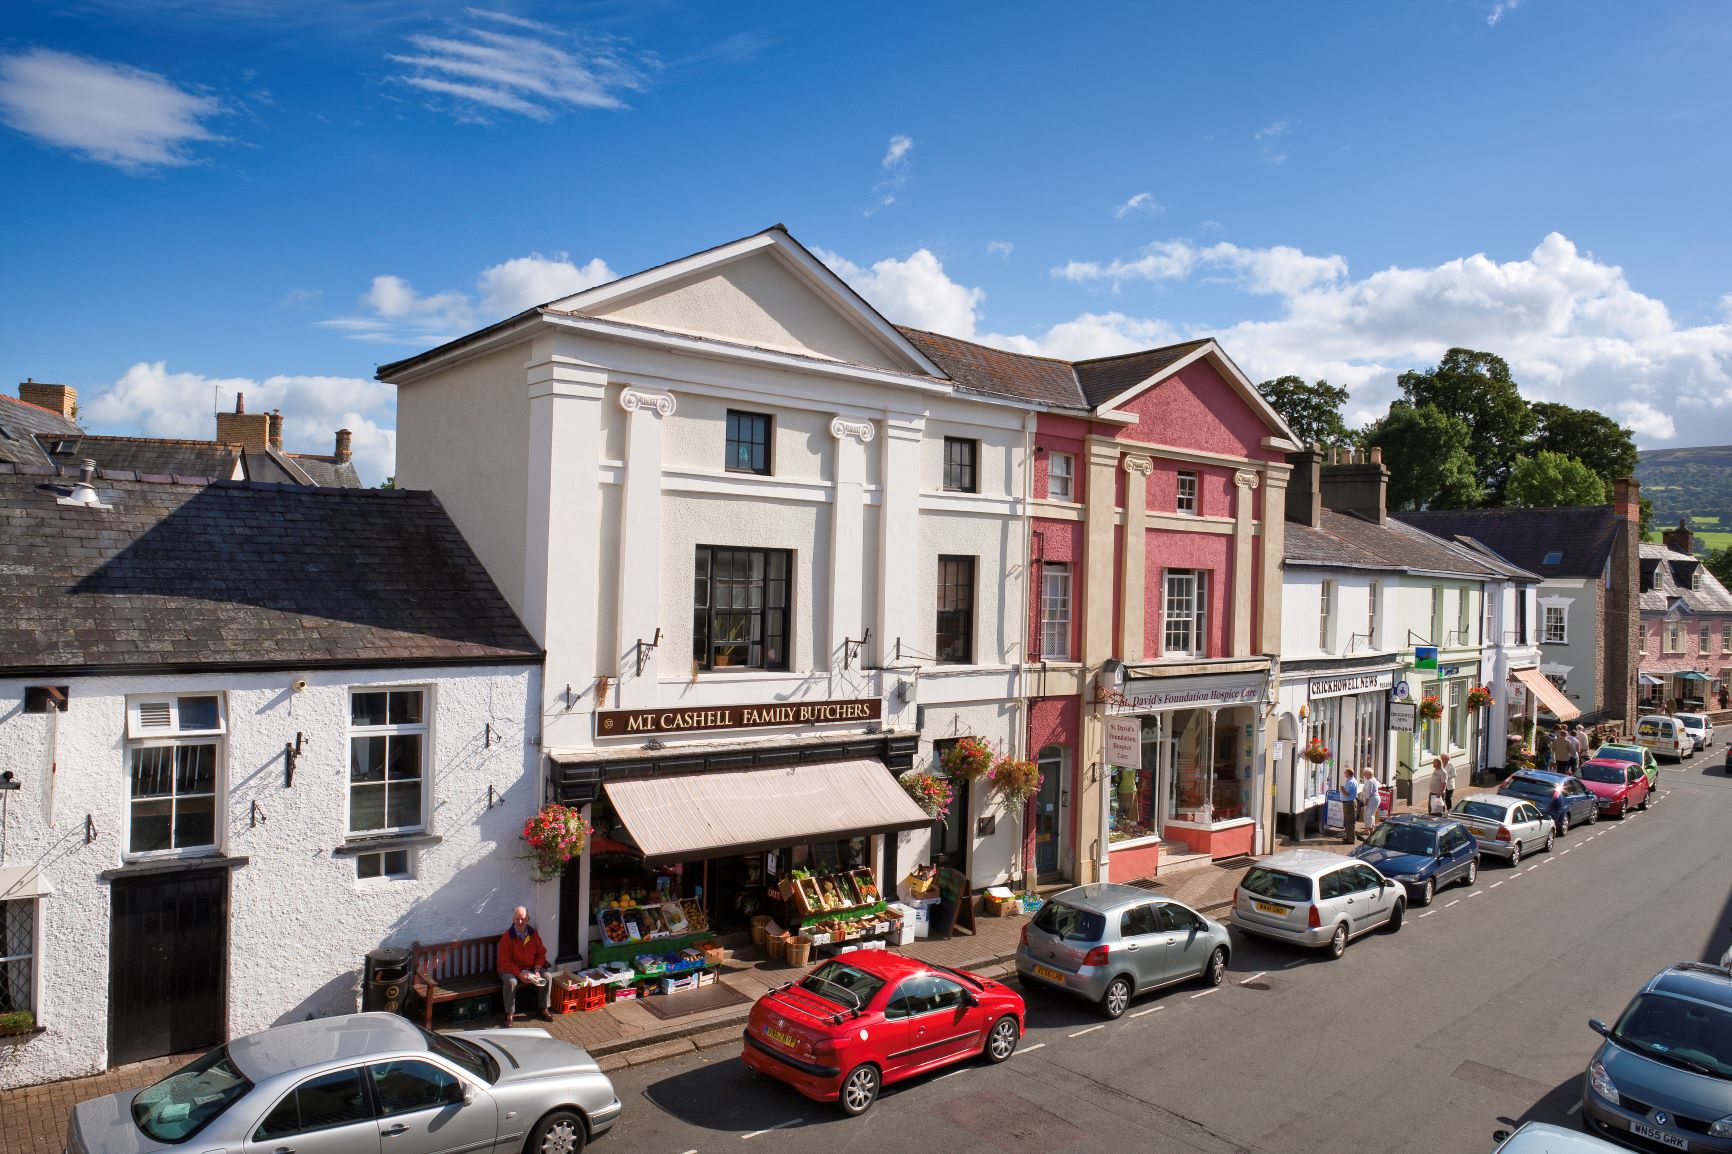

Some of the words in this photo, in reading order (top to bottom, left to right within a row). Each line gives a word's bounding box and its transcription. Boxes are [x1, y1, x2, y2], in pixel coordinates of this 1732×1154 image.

[1312, 678, 1359, 695] CRICKHOWELL
[1360, 675, 1378, 689] NEWS
[1133, 694, 1162, 706] David's
[1164, 691, 1208, 705] Foundation
[1210, 689, 1240, 702] Hospice
[1241, 688, 1257, 698] Care
[660, 710, 733, 730] CASHELL
[742, 707, 797, 724] FAMILY
[799, 703, 871, 721] BUTCHERS
[1117, 724, 1135, 732] David's
[1109, 733, 1136, 743] Foundation
[1113, 742, 1132, 751] Hospice
[1117, 752, 1129, 760] Care
[1634, 1123, 1661, 1140] WN55
[1663, 1132, 1685, 1148] GRK
